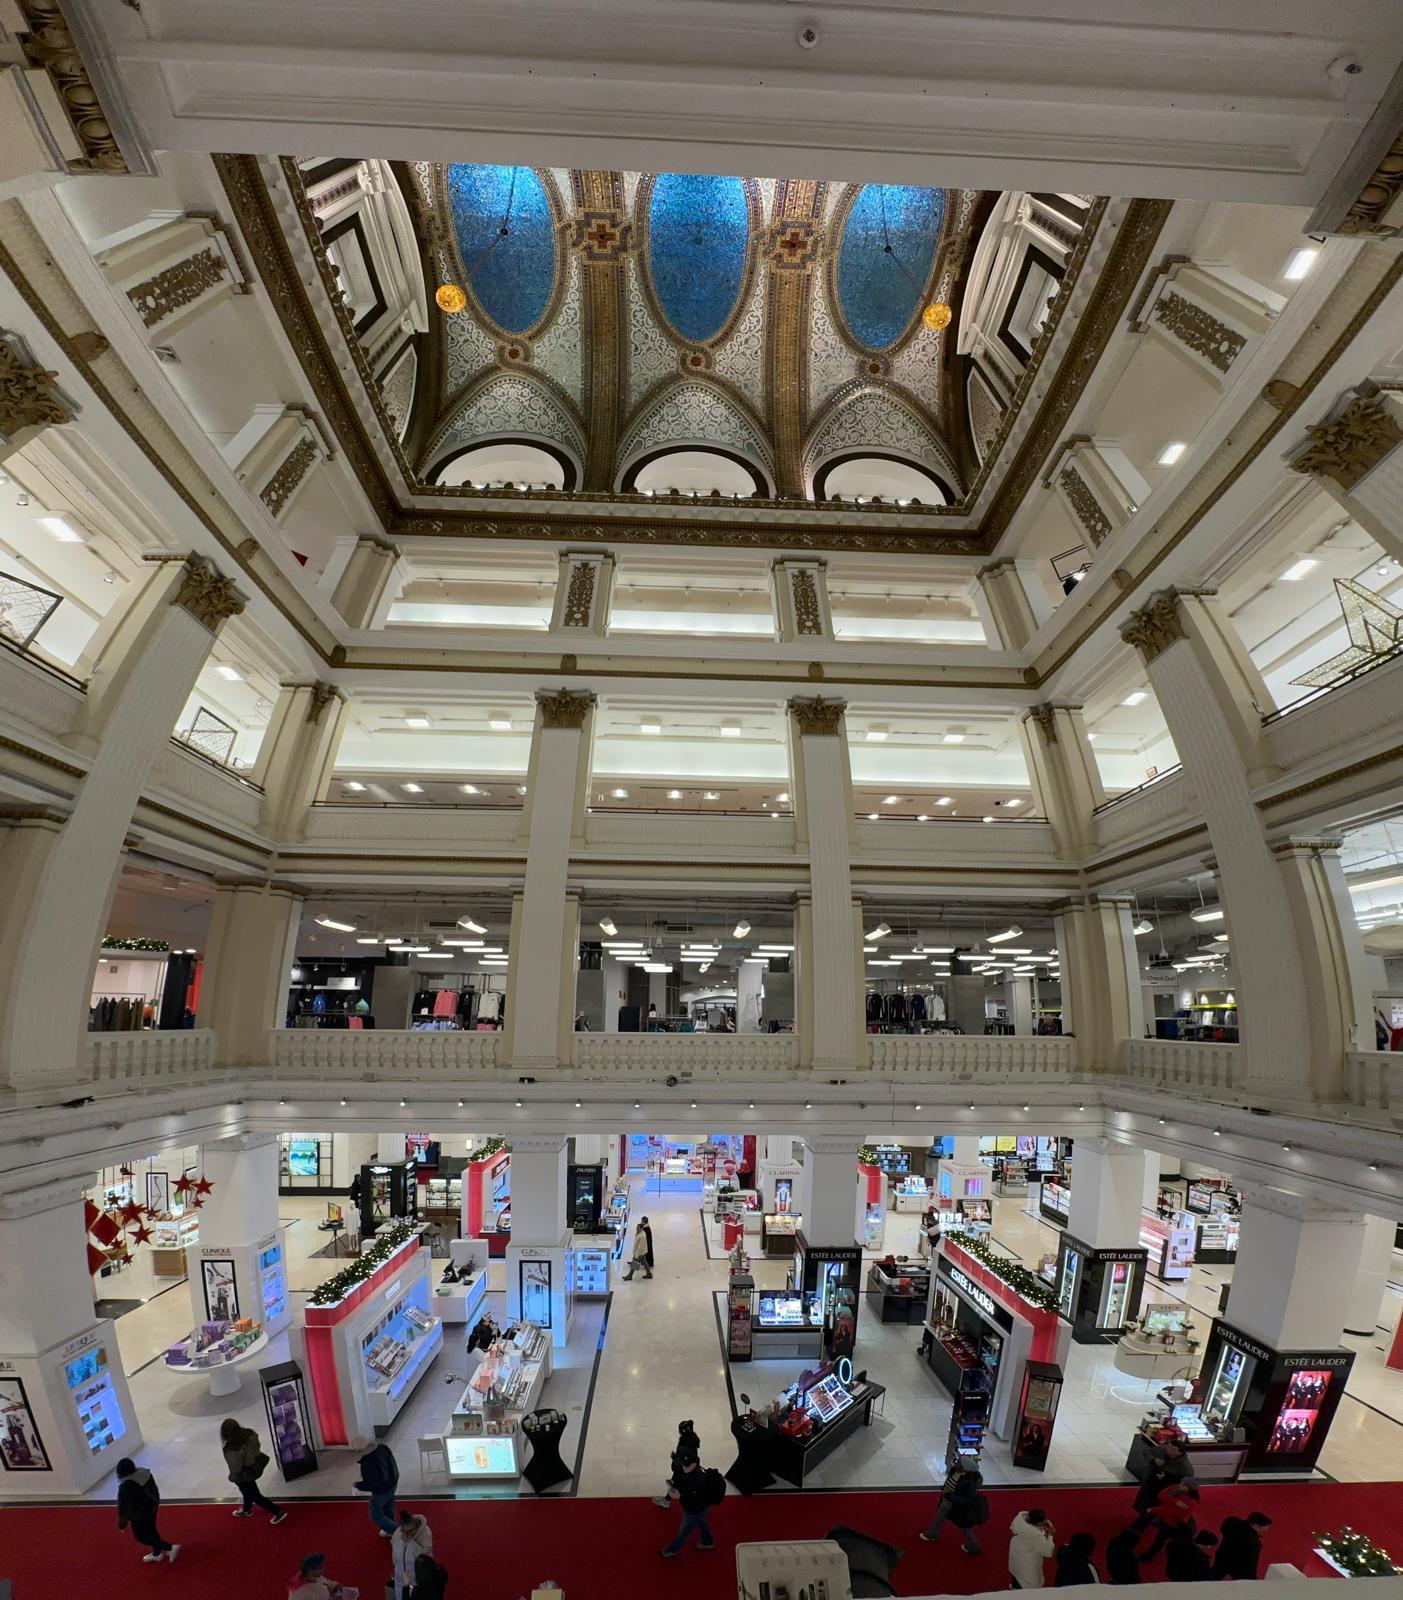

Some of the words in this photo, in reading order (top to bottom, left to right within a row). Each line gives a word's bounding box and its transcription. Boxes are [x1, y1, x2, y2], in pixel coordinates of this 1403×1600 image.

[968, 1283, 995, 1315] LAUDER
[1239, 1338, 1269, 1360] LAUDER
[1311, 1358, 1347, 1366] LAUDER
